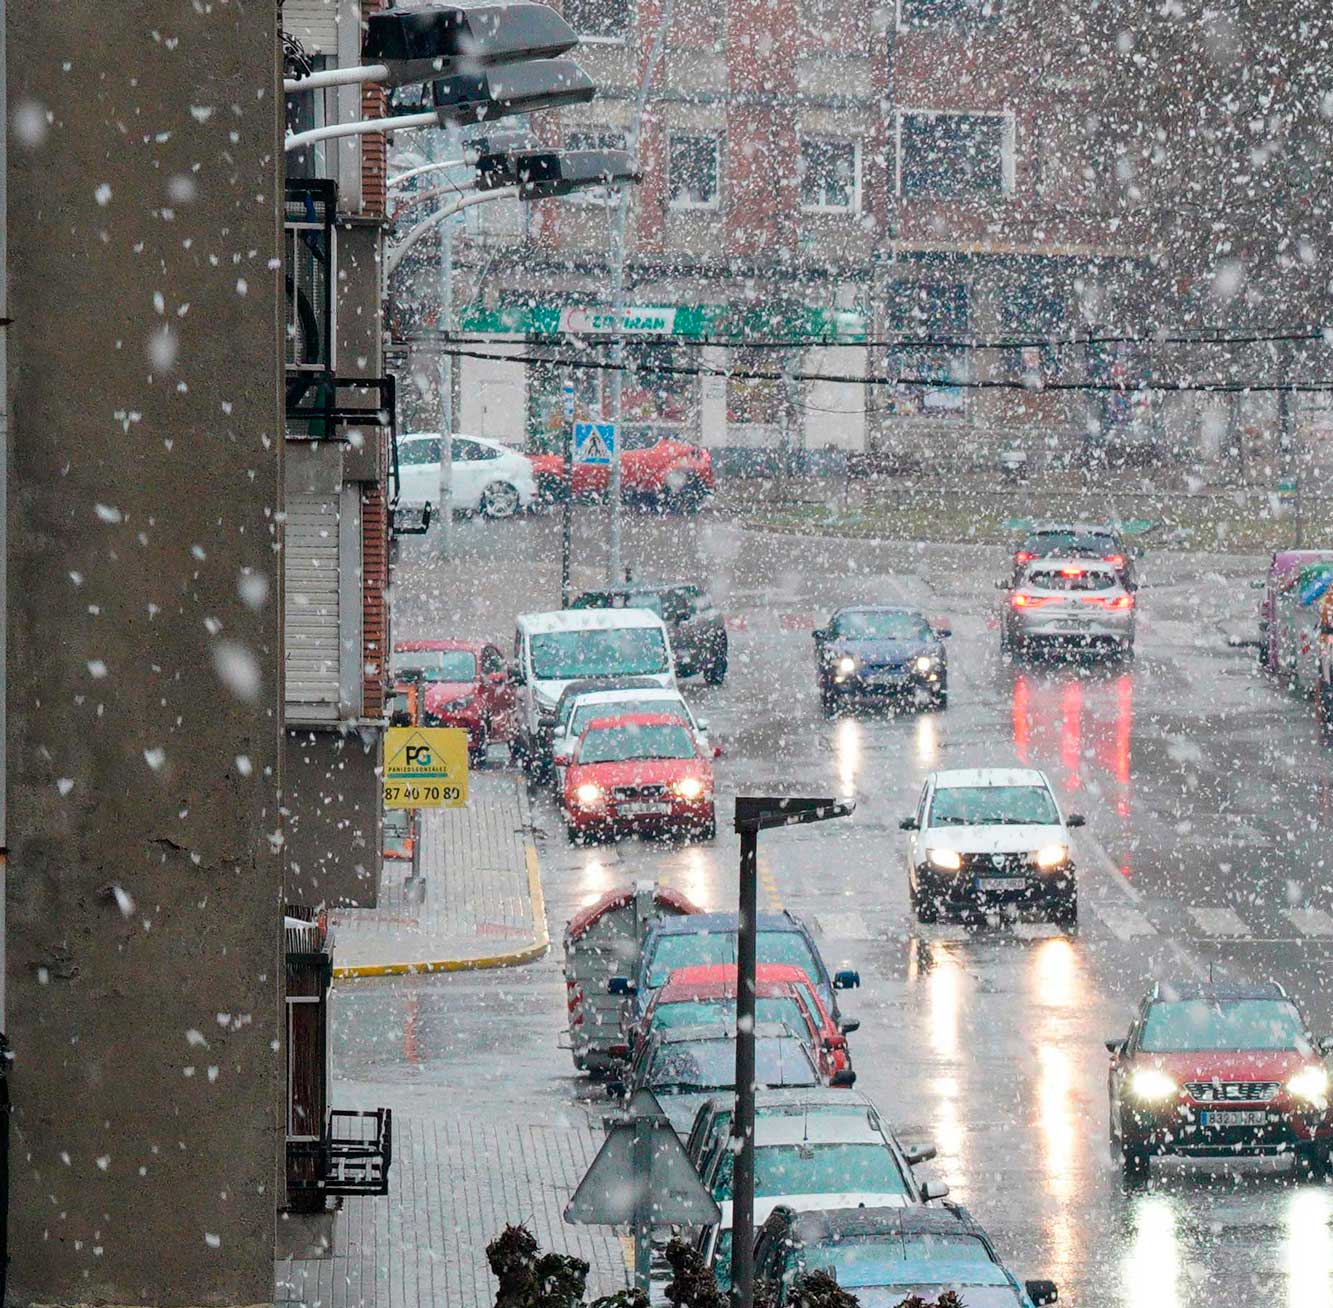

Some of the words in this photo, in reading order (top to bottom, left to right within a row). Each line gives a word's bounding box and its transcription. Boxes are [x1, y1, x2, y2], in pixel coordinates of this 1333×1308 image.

[406, 745, 432, 766] PG
[404, 787, 420, 800] 40
[424, 787, 439, 800] 70
[443, 786, 460, 800] 80
